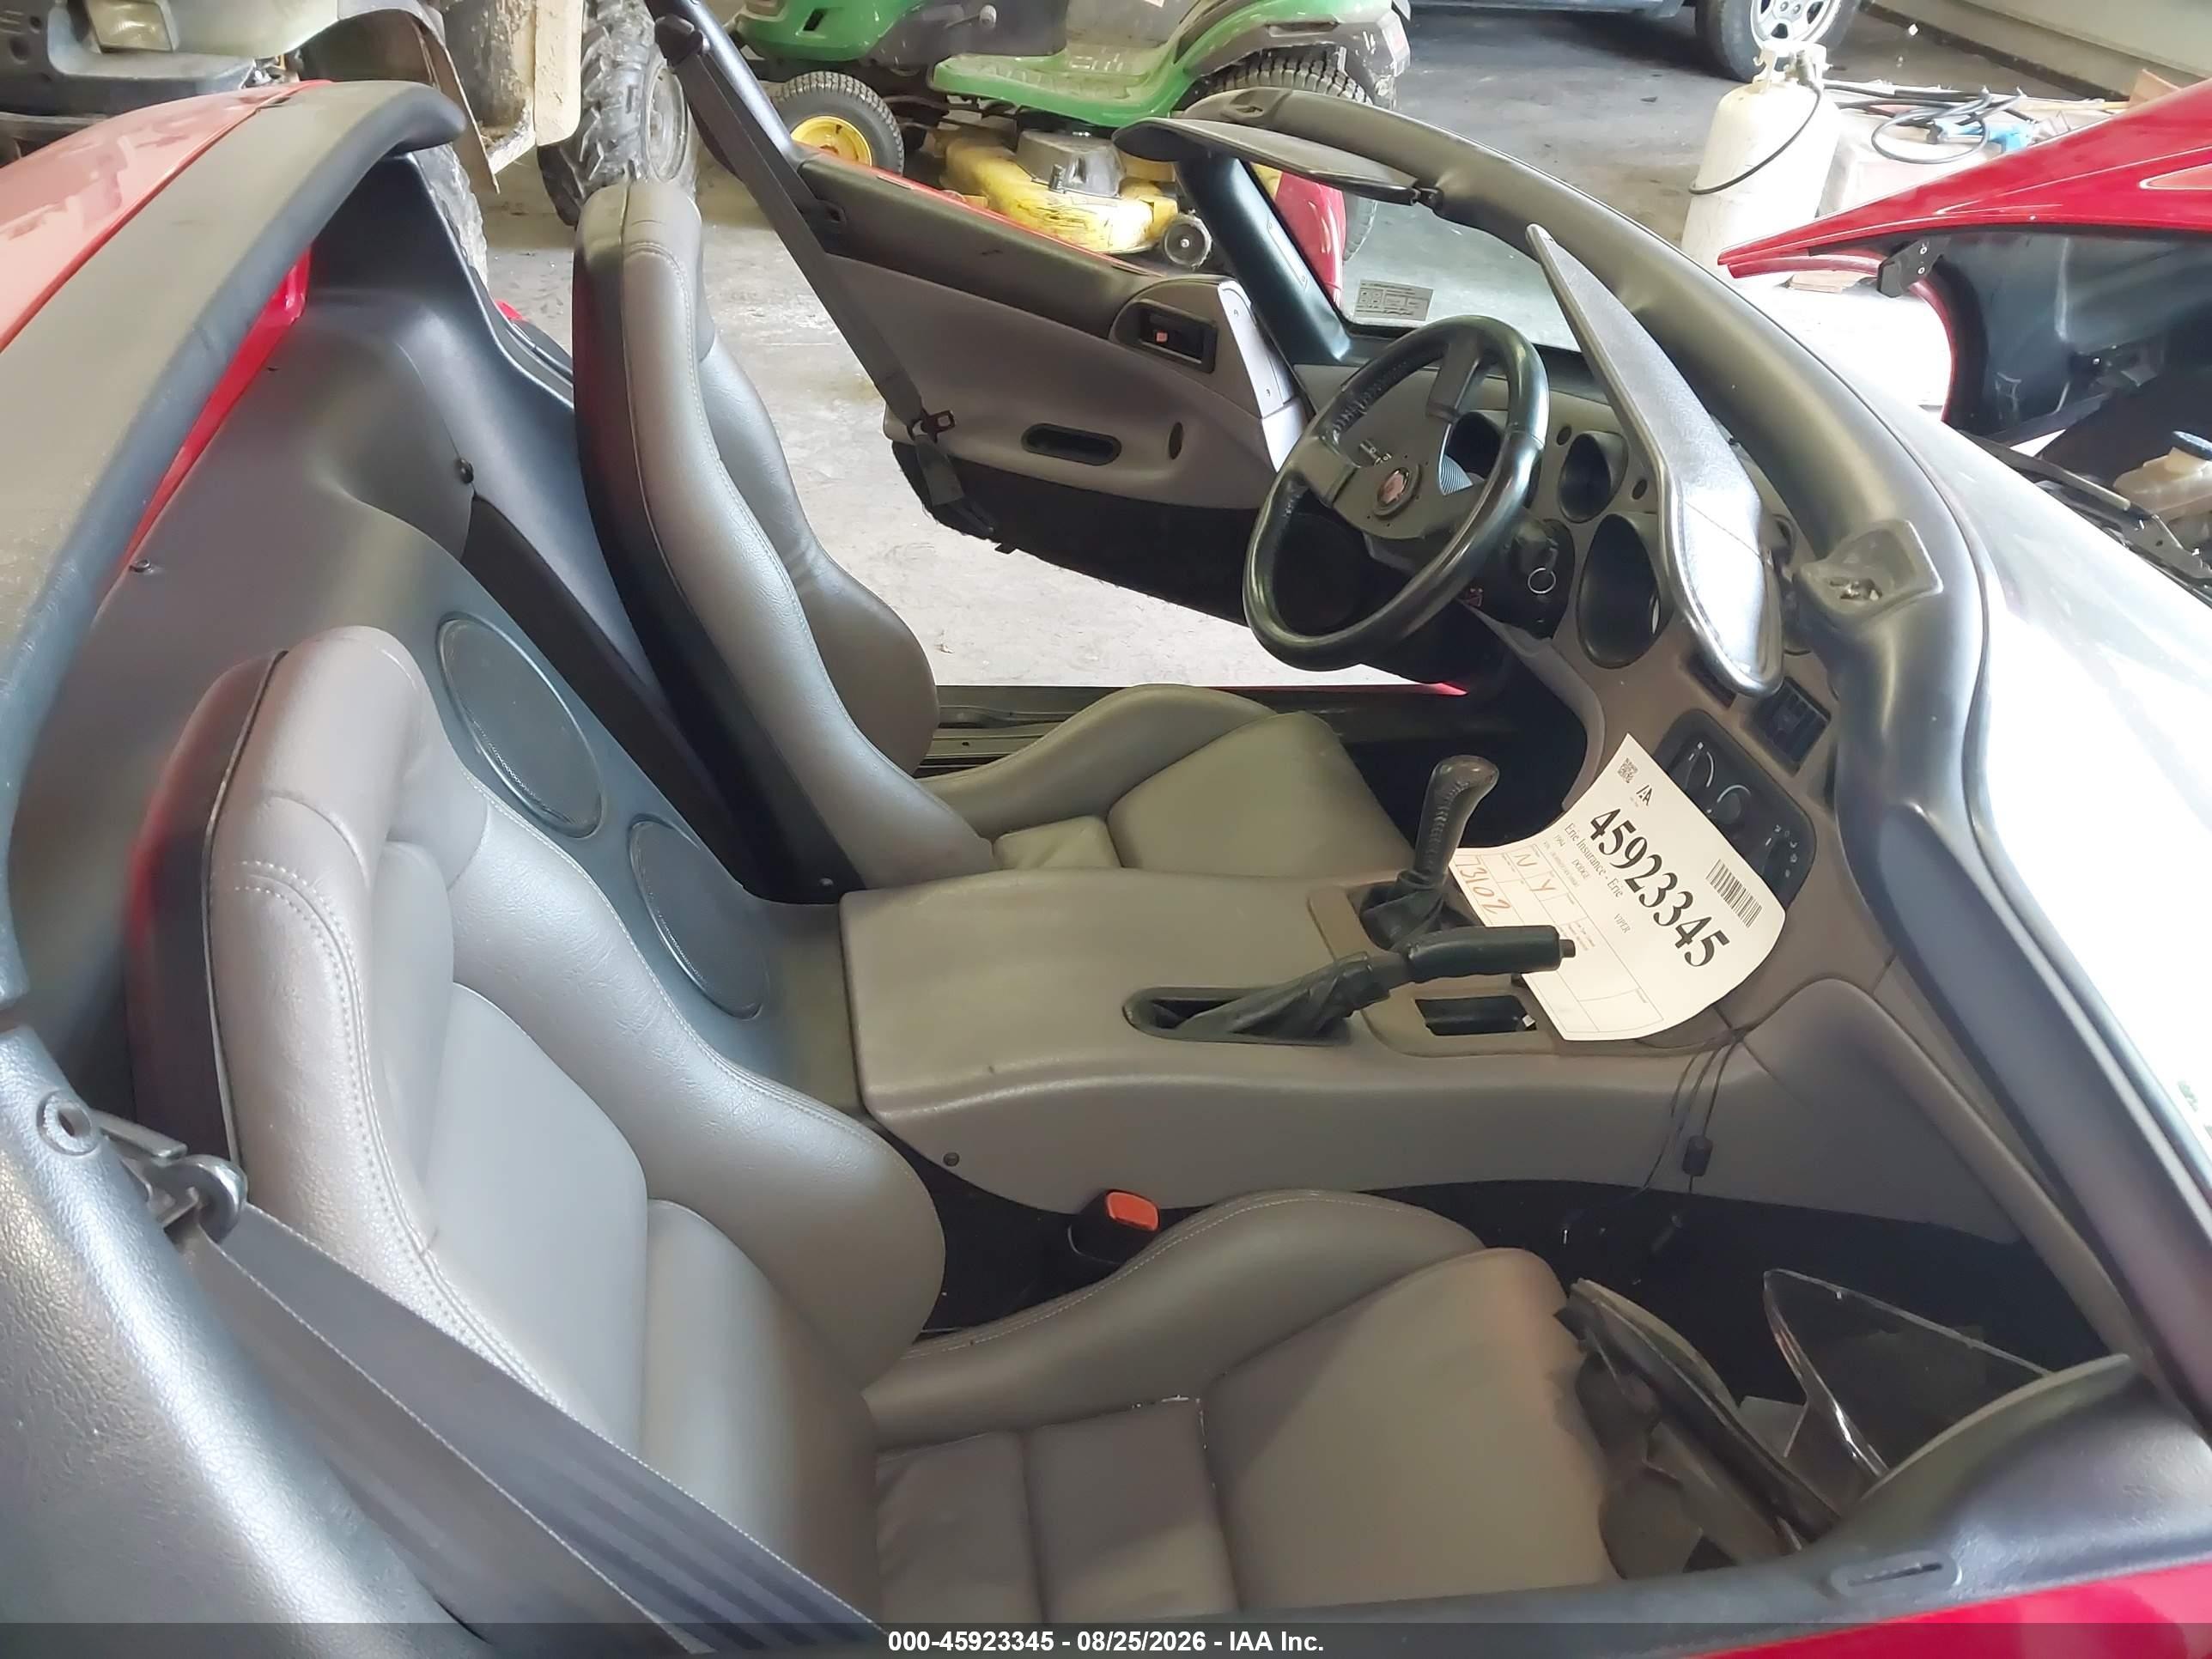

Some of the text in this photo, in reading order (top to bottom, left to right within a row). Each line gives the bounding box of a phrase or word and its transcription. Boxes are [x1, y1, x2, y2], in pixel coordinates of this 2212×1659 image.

[1565, 823, 1579, 842] Erie
[1577, 838, 1607, 876] Insurance
[1607, 878, 1623, 898] Erie
[1571, 859, 1589, 880] DODGE
[1613, 913, 1631, 934] VIPER
[1590, 808, 1730, 967] 45923345
